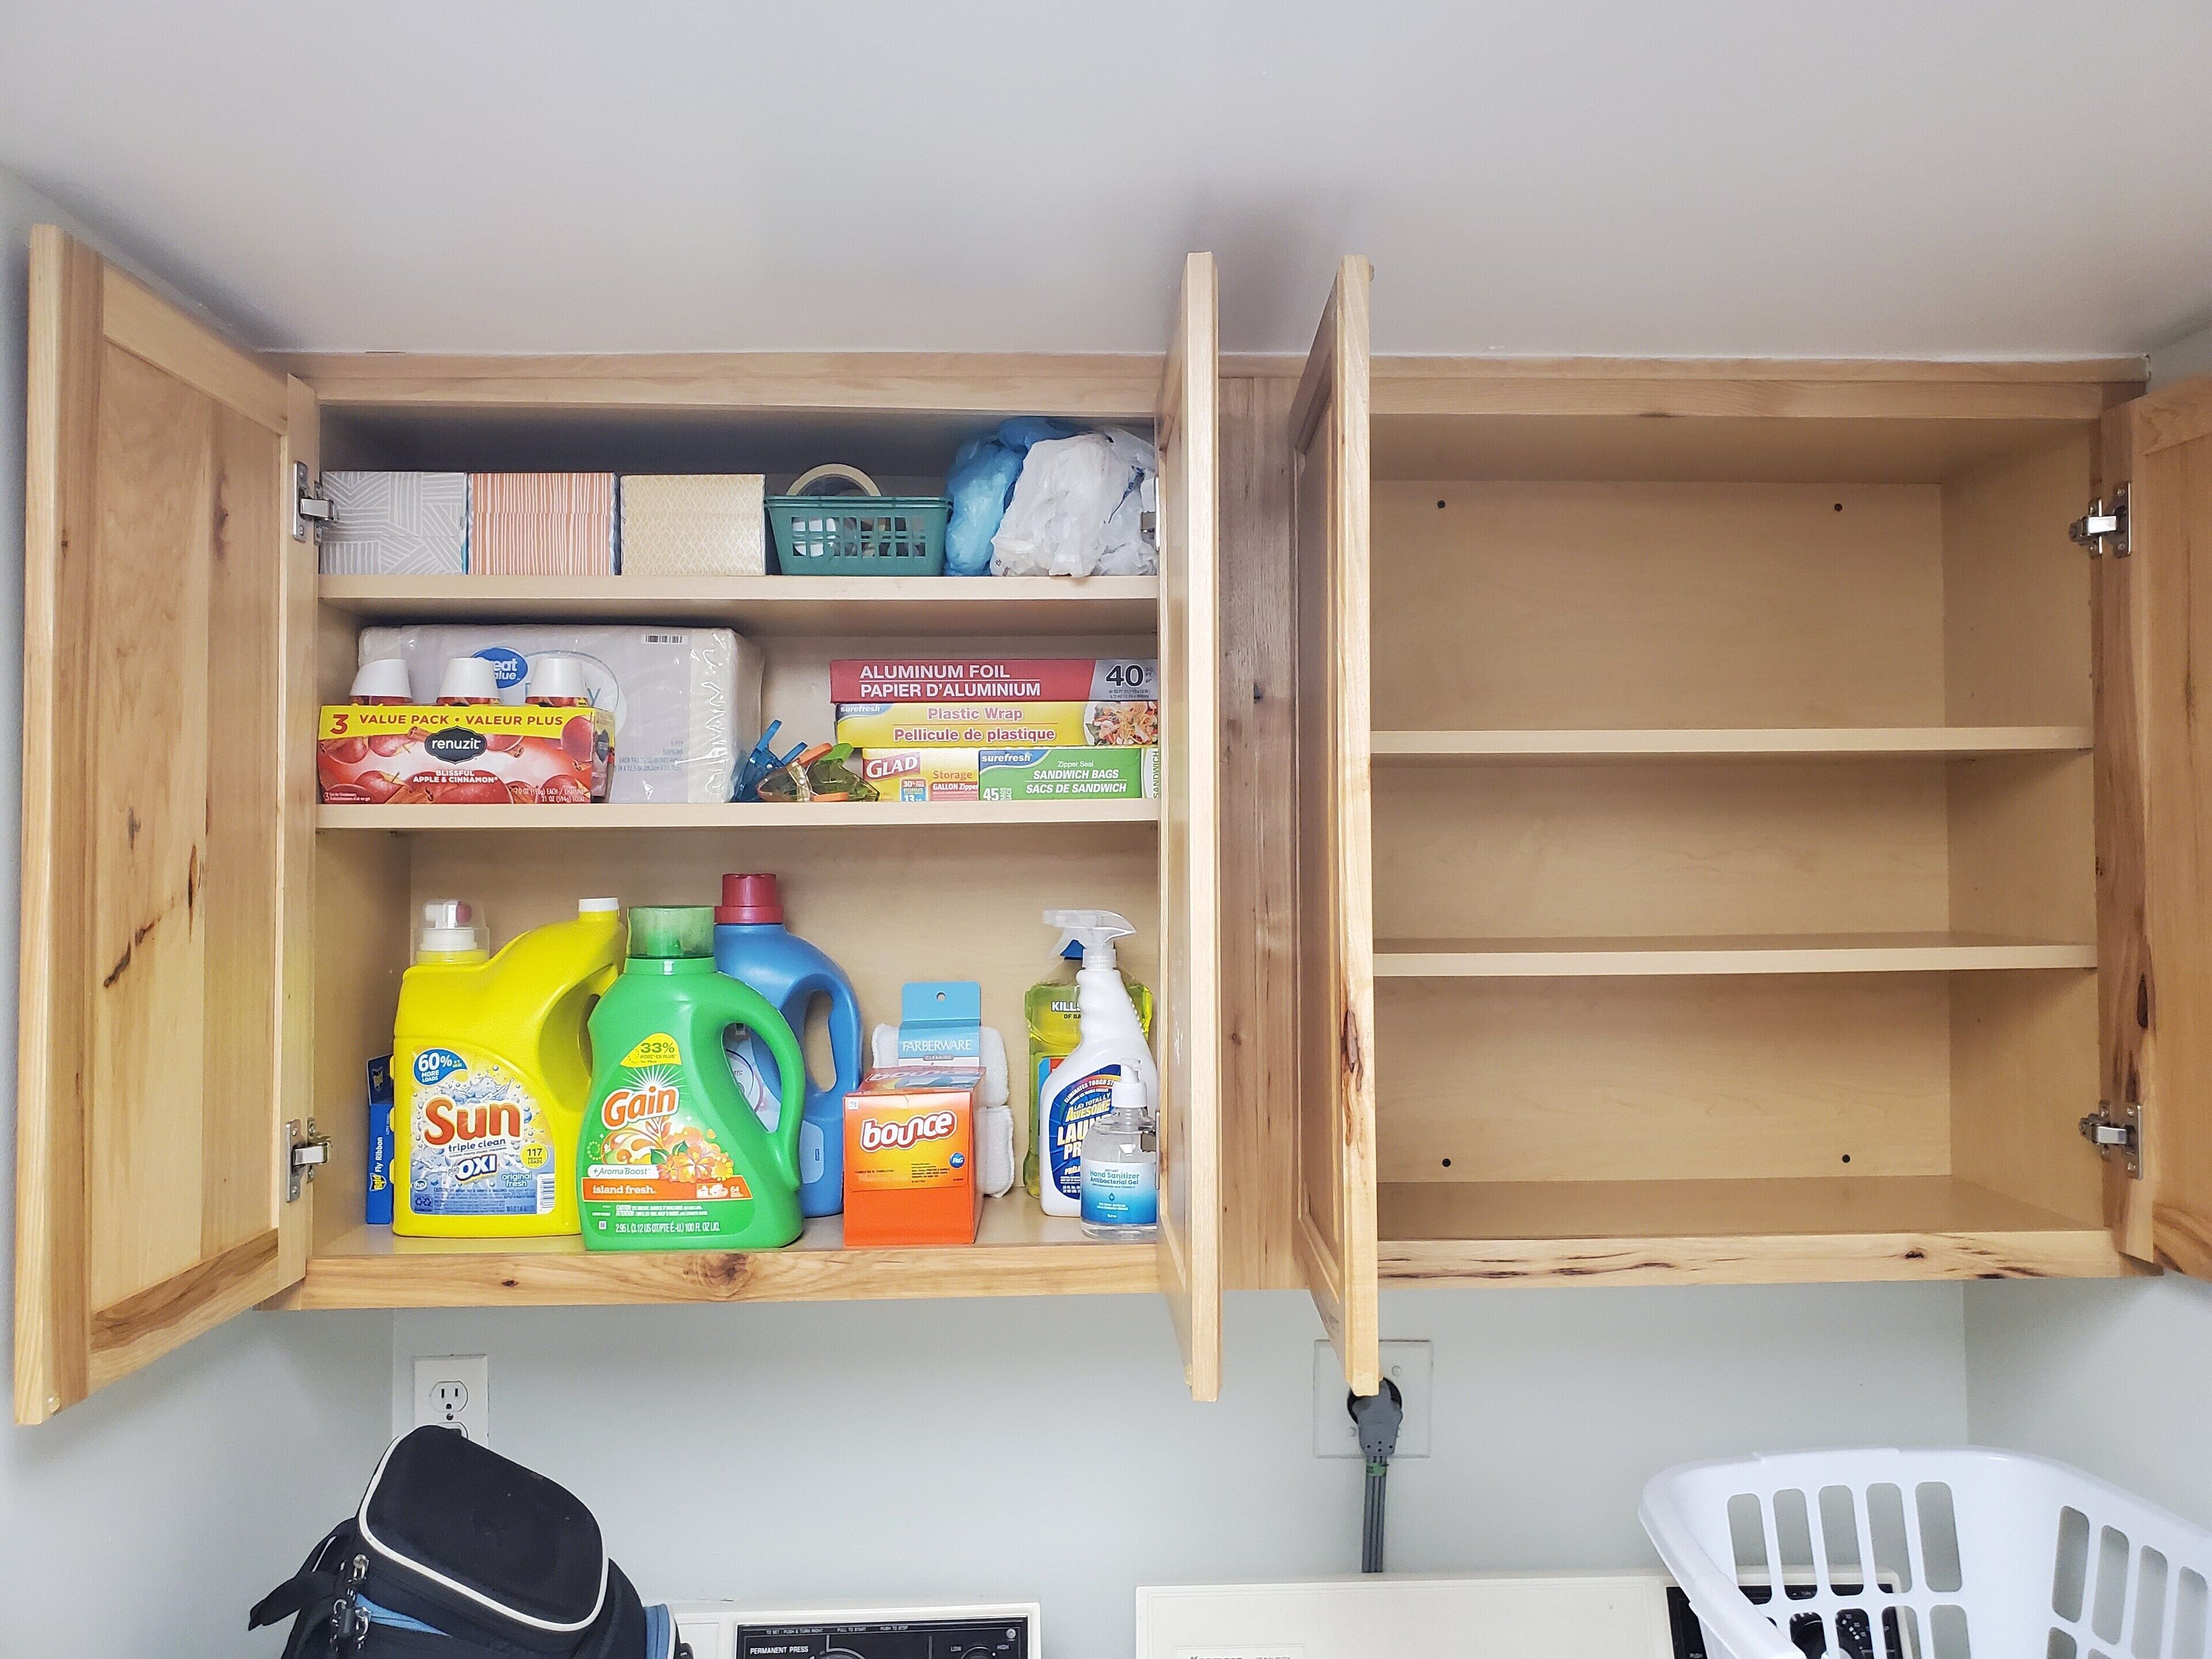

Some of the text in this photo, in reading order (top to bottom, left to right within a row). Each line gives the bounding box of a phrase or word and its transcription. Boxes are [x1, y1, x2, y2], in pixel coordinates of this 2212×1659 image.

[490, 658, 517, 672] eat
[494, 671, 517, 680] alue
[859, 665, 1010, 679] ALUMINUM FOIL
[1105, 665, 1144, 687] 40
[861, 683, 1040, 697] PAPIER D'ALUMINIUM
[928, 707, 1023, 721] Plastic Wrap
[329, 714, 563, 734] 3 VALUE PACK VALEUR PLUS
[894, 728, 1056, 743] Pellicule de plastique
[432, 737, 482, 749] renuzit
[982, 753, 1031, 762] surefresh
[1058, 760, 1079, 768] Zipper
[866, 756, 918, 779] GLAD
[933, 771, 973, 781] Storage
[1033, 769, 1119, 780] SANDWICH BAGS
[983, 787, 999, 800] 45
[1025, 783, 1127, 794] SACS DE SANDWICH
[641, 1042, 675, 1053] 33%
[903, 1039, 972, 1052] FARBERWARE
[418, 1052, 453, 1072] 60%
[421, 1070, 440, 1078] MORE
[1063, 1082, 1089, 1104] ELIMINATES
[1085, 1092, 1111, 1107] TOTALLY
[603, 1086, 676, 1127] Gain
[1065, 1098, 1111, 1123] AWESOME
[424, 1099, 520, 1146] Sun
[863, 1113, 953, 1149] bounce
[375, 1137, 384, 1161] Ribbon
[448, 1139, 506, 1152] triple clean
[1063, 1141, 1082, 1160] PR
[527, 1148, 543, 1157] 117
[375, 1163, 384, 1173] Fly
[448, 1154, 497, 1181] plus OXI
[502, 1172, 532, 1181] original
[1090, 1176, 1127, 1185] Antibacterial
[593, 1185, 624, 1194] island
[627, 1223, 631, 1233] L
[643, 1222, 651, 1233] US
[685, 1222, 695, 1232] 100
[702, 1222, 710, 1232] OZ
[750, 1647, 787, 1655] PERMANENT
